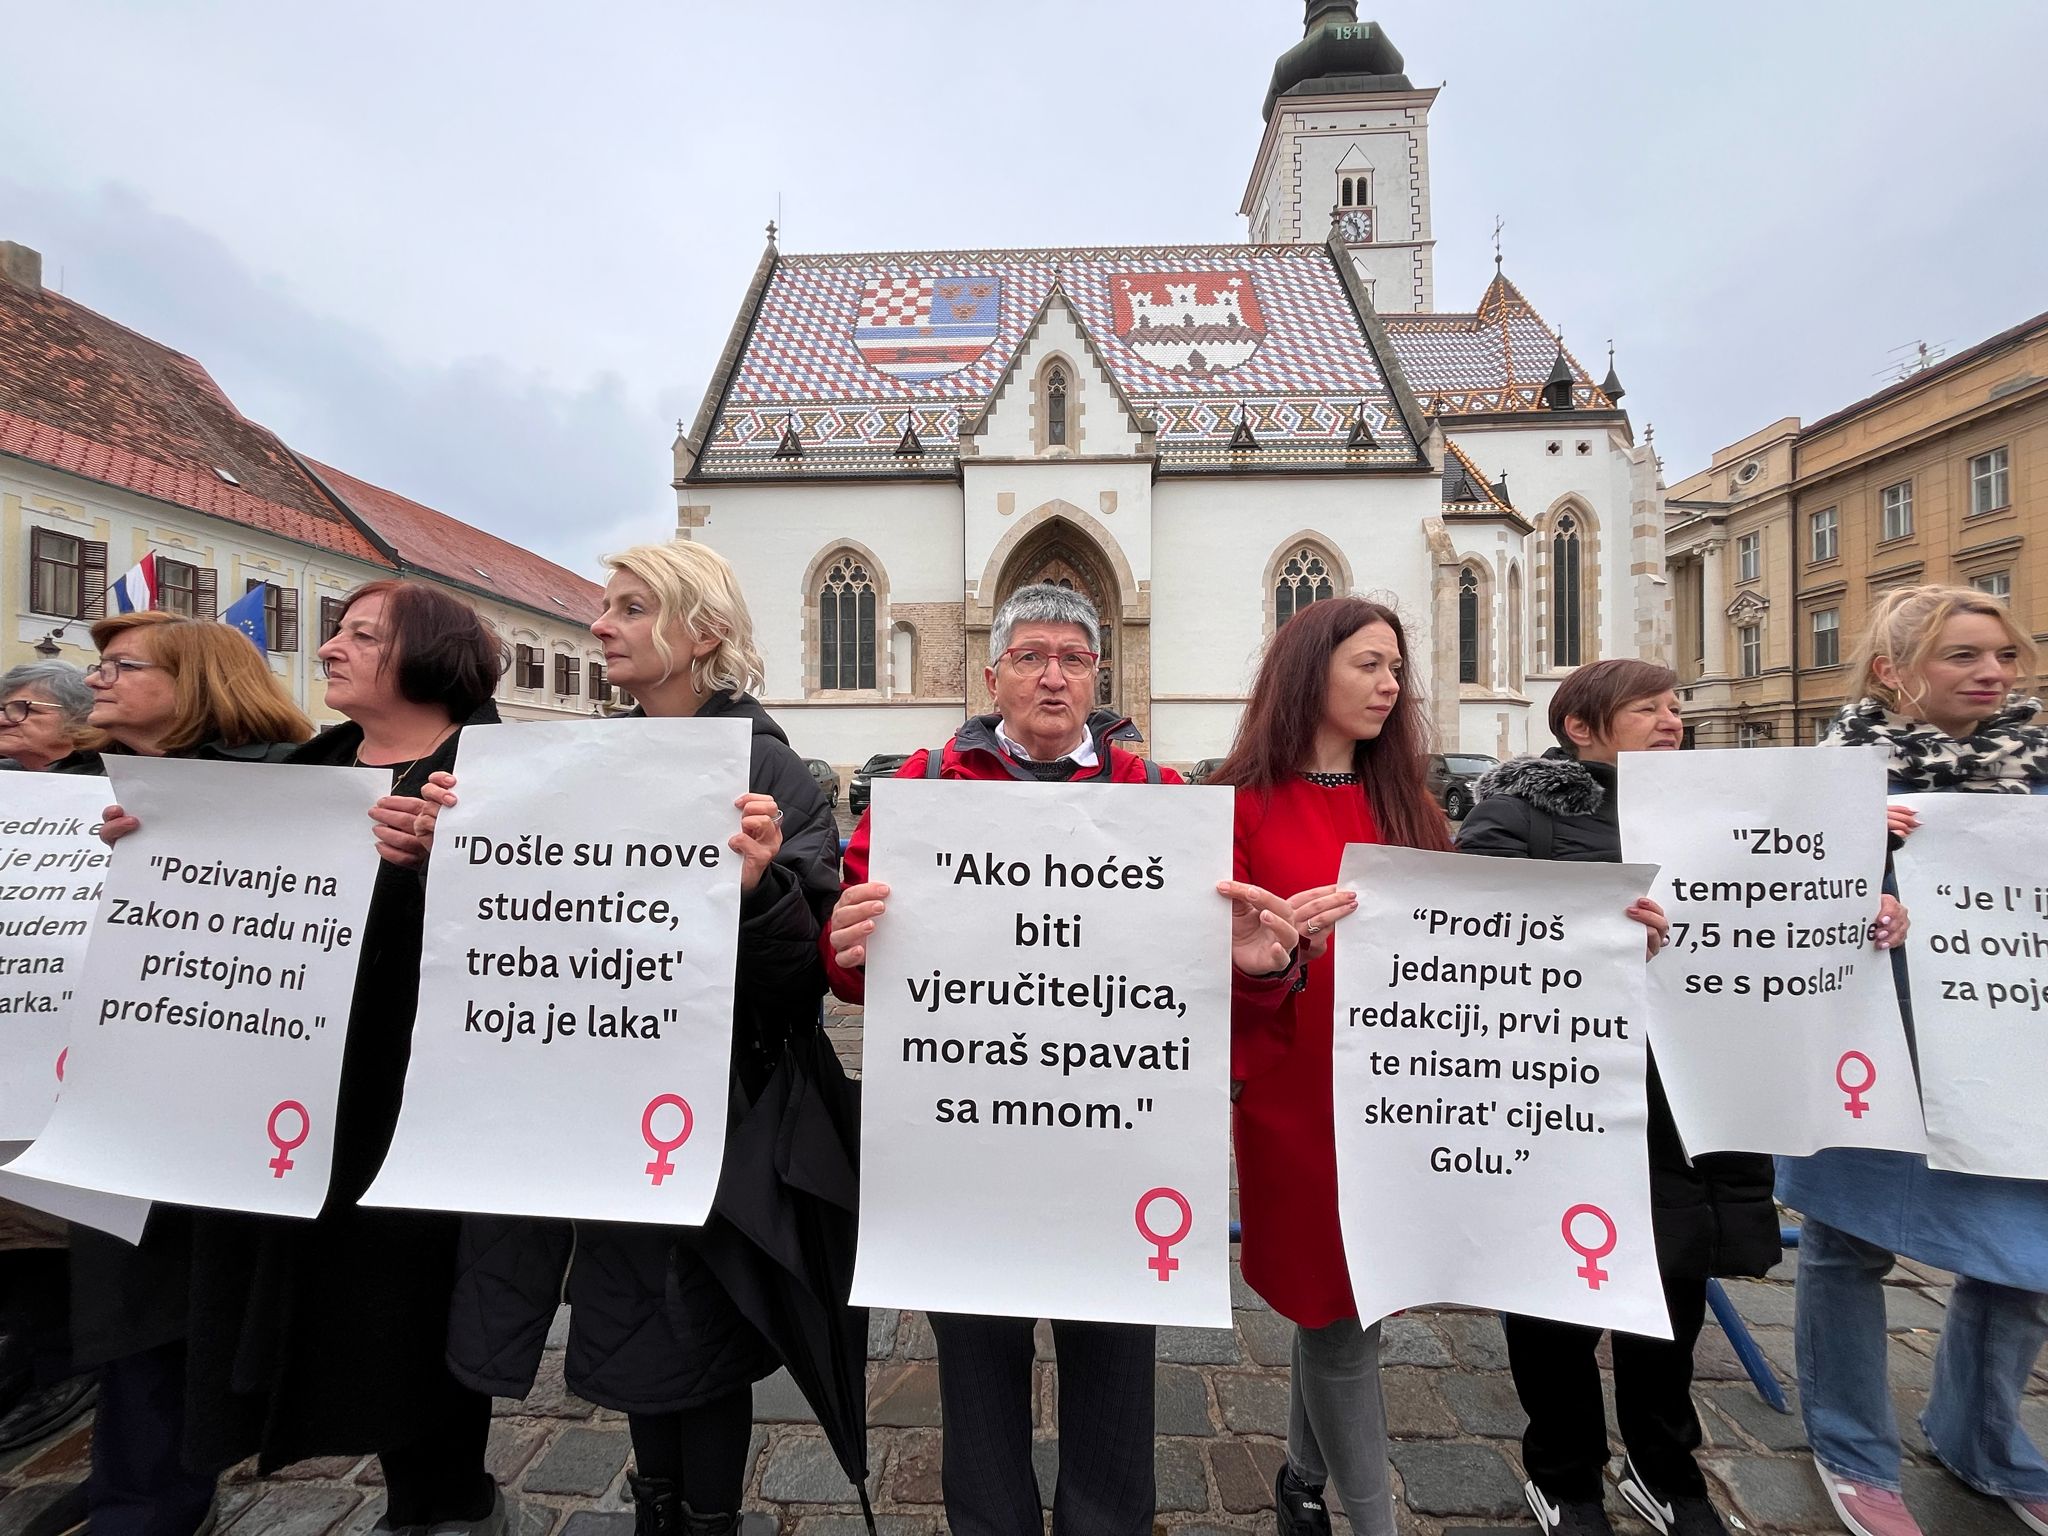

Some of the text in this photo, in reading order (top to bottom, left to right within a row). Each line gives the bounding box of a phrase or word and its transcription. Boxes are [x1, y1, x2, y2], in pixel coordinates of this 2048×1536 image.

[1336, 26, 1370, 40] 1841
[454, 834, 720, 868] "Došle su nove
[1732, 827, 1826, 861] "Zbog
[150, 855, 337, 899] "Pozivanje na
[936, 852, 1165, 890] "Ako hoćeš
[477, 890, 679, 932] studentice,
[1671, 876, 1868, 909] temperature
[1936, 884, 1994, 911] “Je
[2004, 885, 2022, 912] l'
[106, 898, 353, 953] Zakon o radu nije
[1015, 912, 1082, 948] biti
[1413, 907, 1565, 946] “Prođi još
[1664, 917, 1877, 954] 7,5 ne izostaje
[1930, 929, 1971, 955] od
[140, 950, 307, 991] pristojno ni
[466, 945, 683, 990] treba vidjet'
[1388, 953, 1582, 994] jedanput po
[1684, 964, 1854, 1003] se s posla!"
[906, 969, 1187, 1019] vjeručiteljica,
[1941, 980, 1979, 1001] za
[98, 996, 326, 1041] profesionalno."
[464, 1000, 678, 1045] koja je laka"
[1349, 1000, 1629, 1043] redakciji, prvi put
[902, 1032, 1190, 1077] moraš spavati
[1369, 1049, 1600, 1090] te nisam uspio
[935, 1097, 1153, 1130] sa mnom."
[1364, 1096, 1605, 1137] skenirat' cijelu.
[1430, 1146, 1530, 1175] Golu.”
